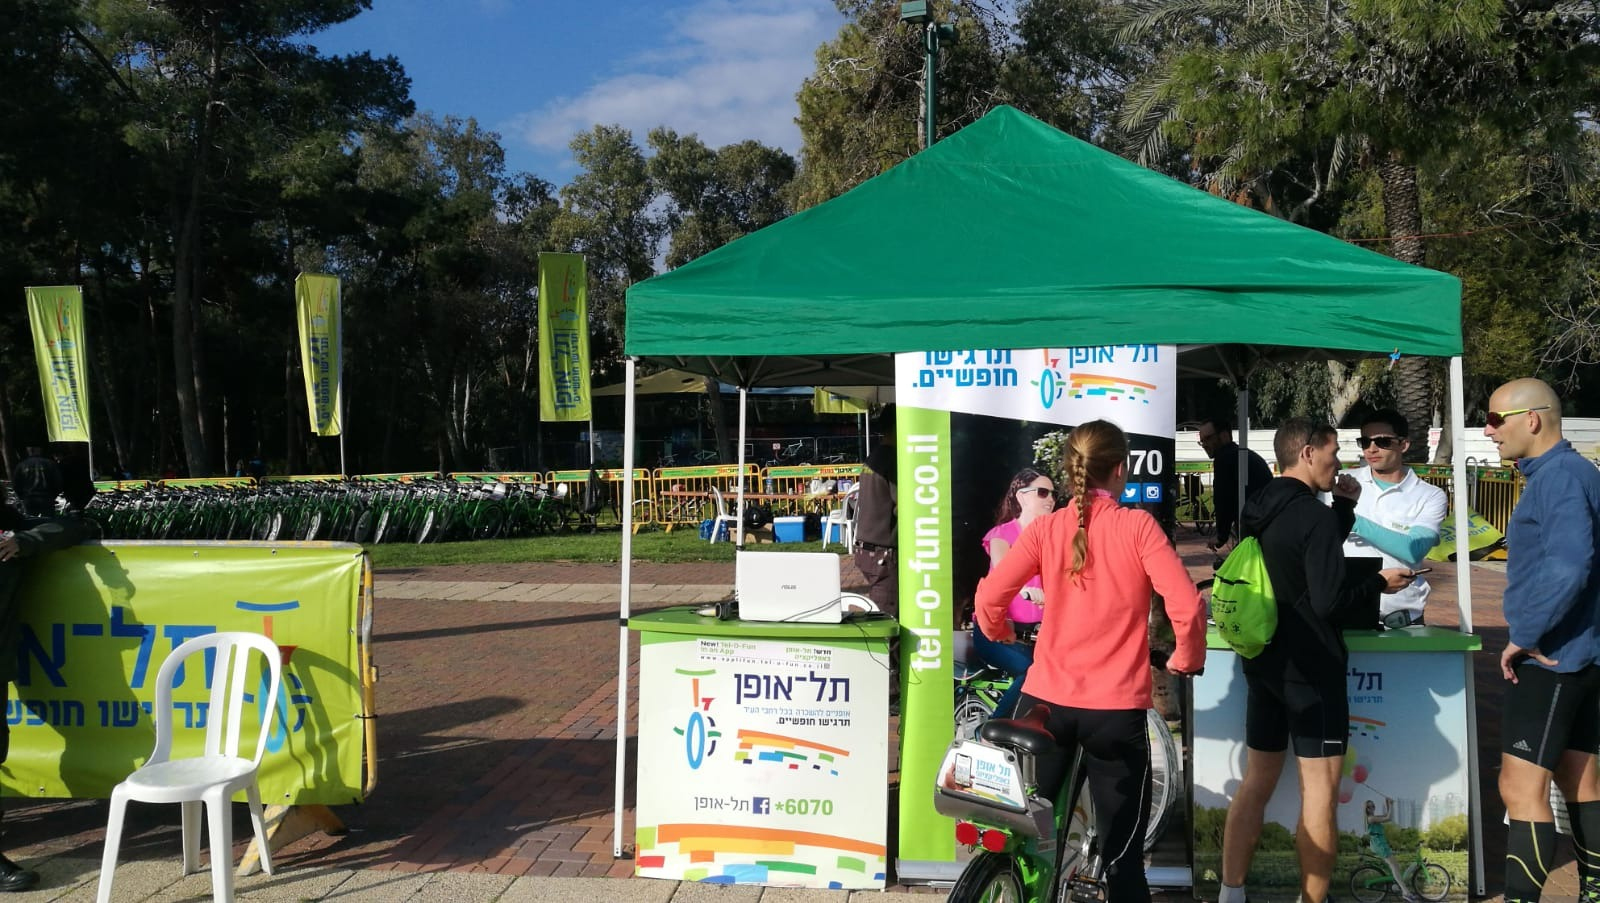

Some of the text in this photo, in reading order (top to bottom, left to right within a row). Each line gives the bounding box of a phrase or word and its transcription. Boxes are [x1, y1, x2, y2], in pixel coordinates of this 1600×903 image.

[912, 368, 1018, 388] חופשיים.
[1126, 449, 1163, 476] 70
[907, 434, 942, 672] tel-o-fun.co.il
[734, 670, 850, 705] תל-אופן
[97, 700, 211, 728] תרישו
[776, 717, 851, 727] תרגישו חופשיים.
[694, 796, 749, 811] תל-אופן
